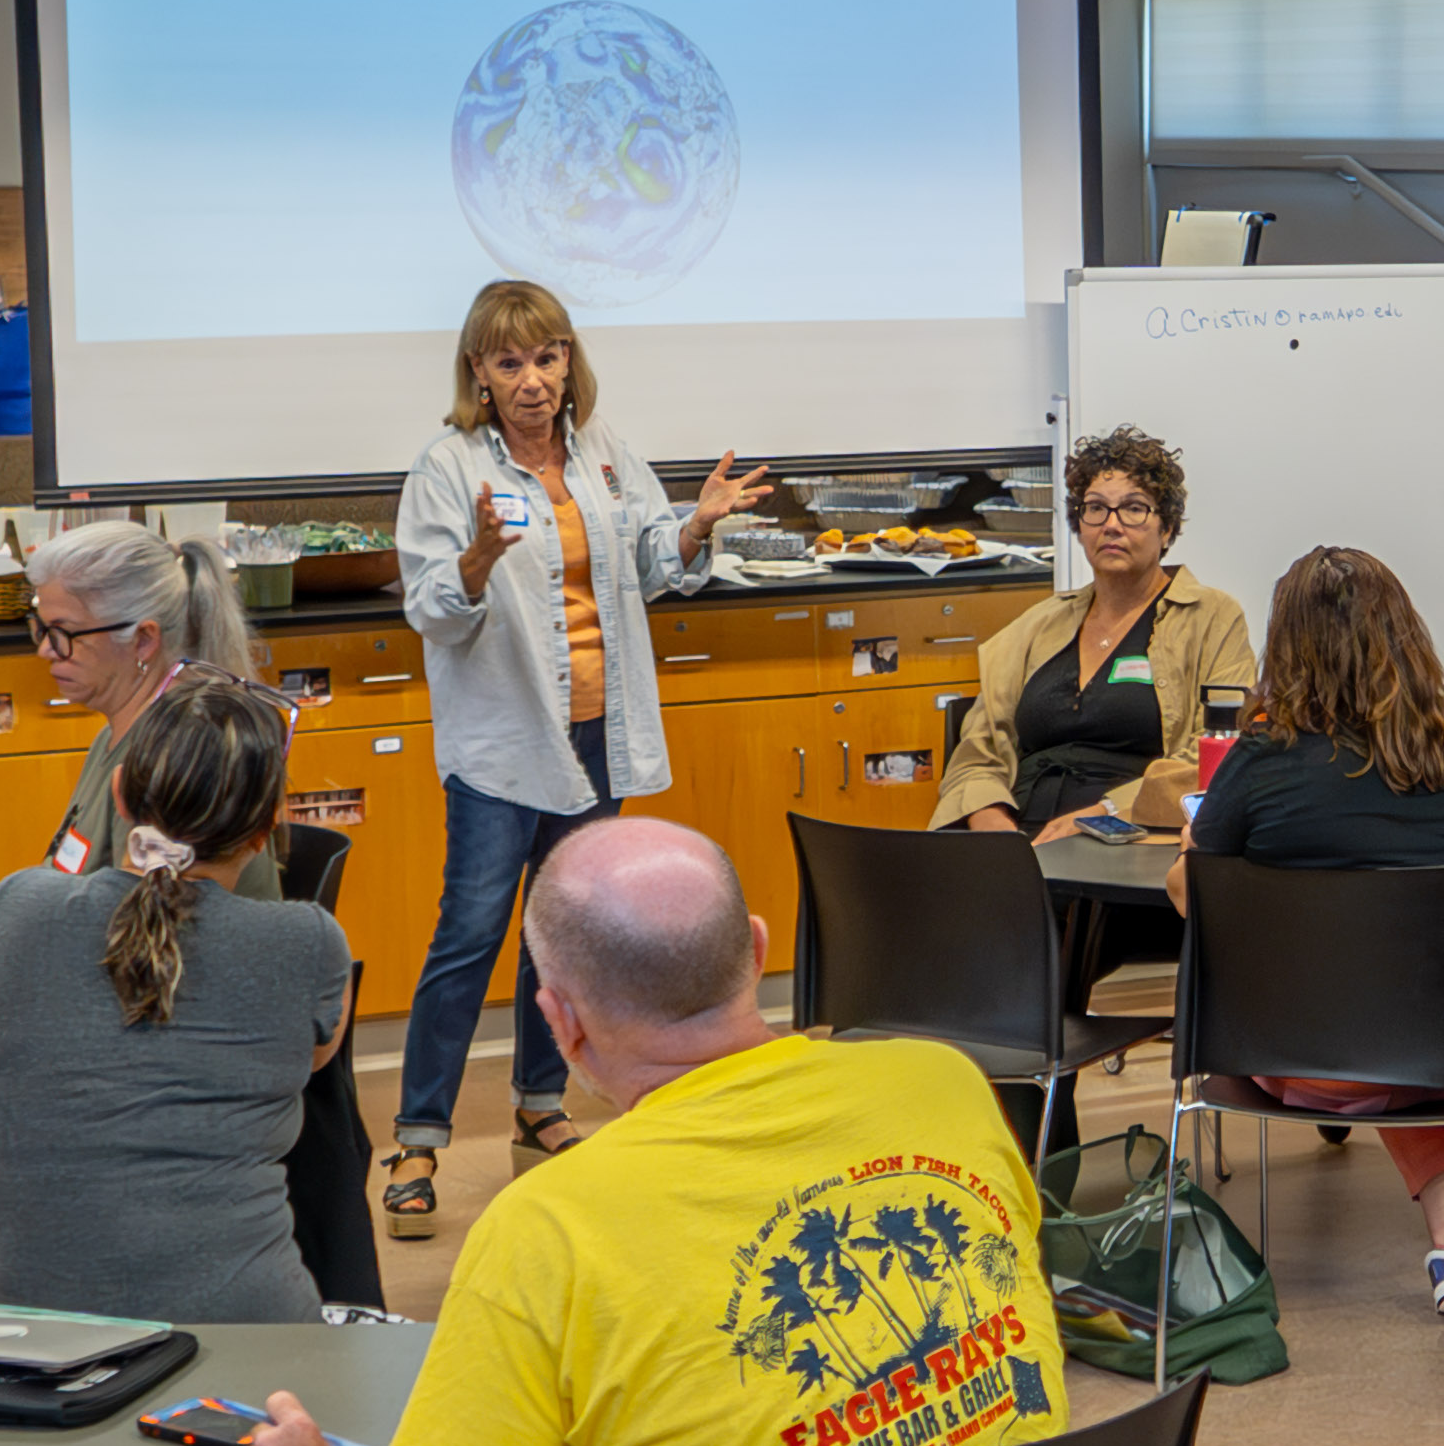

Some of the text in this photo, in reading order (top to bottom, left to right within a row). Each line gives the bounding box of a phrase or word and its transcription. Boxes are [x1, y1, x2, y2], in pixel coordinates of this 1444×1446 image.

[715, 1287, 743, 1336] home
[735, 1241, 760, 1267] the
[756, 1197, 791, 1243] world
[793, 1174, 844, 1214] famous
[847, 1155, 904, 1181] LION
[912, 1155, 962, 1180] FISH
[968, 1172, 1013, 1236] TACOS
[925, 1305, 1026, 1395] RAYS
[941, 1400, 960, 1429] &
[959, 1362, 1010, 1418] GRILL
